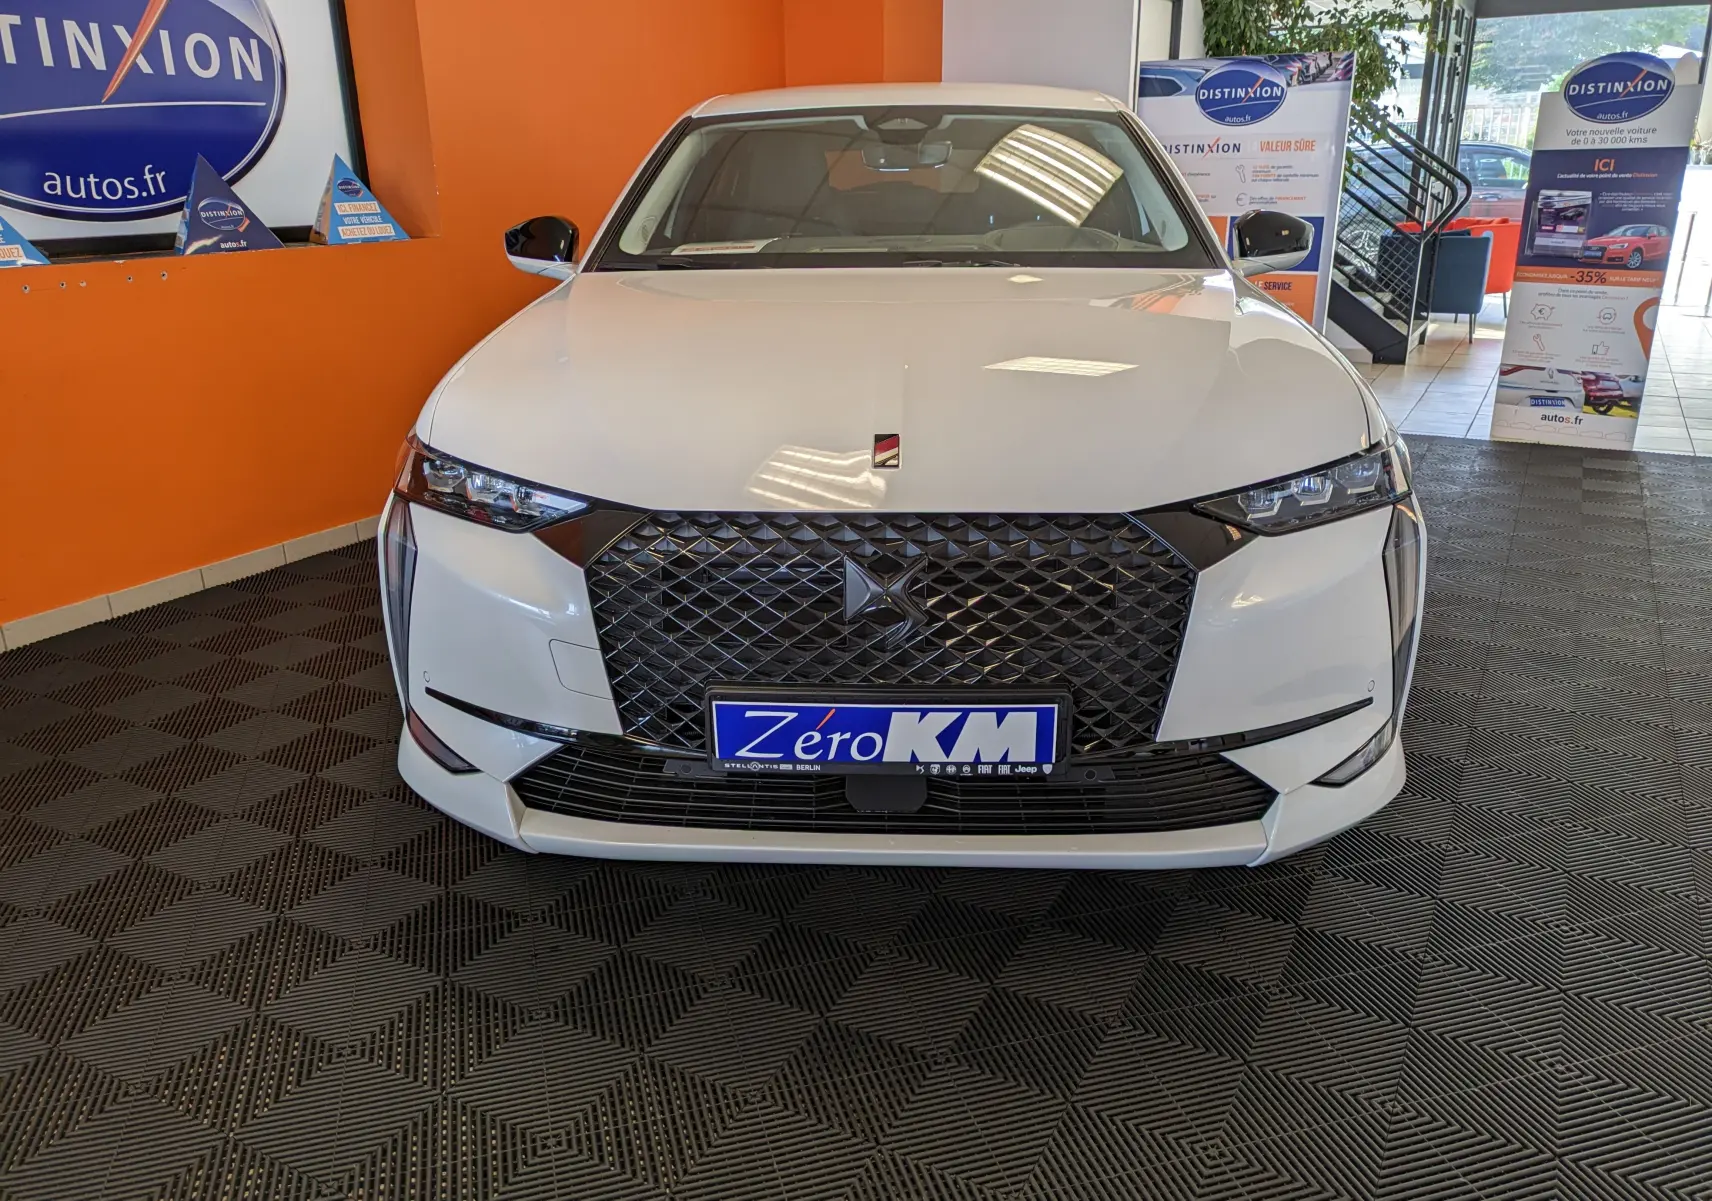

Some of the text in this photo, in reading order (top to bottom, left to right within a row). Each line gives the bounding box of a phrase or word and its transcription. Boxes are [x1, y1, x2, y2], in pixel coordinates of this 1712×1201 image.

[1200, 83, 1282, 101] DISTINXION
[1569, 76, 1669, 97] DISTINXION
[1225, 114, 1251, 123] autos.fr
[1597, 111, 1628, 120] autos.fr
[1566, 126, 1657, 137] Votre nouvelle voiture
[1260, 137, 1316, 152] VALEUR SÛRE
[1571, 137, 1581, 146] de
[1598, 136, 1608, 144] 30
[1611, 136, 1627, 144] 000
[1628, 135, 1648, 144] kms
[1594, 158, 1615, 172] ICI
[43, 164, 167, 201] autos.fr
[201, 208, 243, 218] DISTINXION
[220, 240, 247, 249] autos.fr
[1570, 270, 1607, 284] -35%
[1264, 282, 1292, 290] SERVICE
[1541, 413, 1583, 426] autos.fr
[735, 708, 1038, 762] Zéro KM
[978, 764, 992, 774] FIAT
[1015, 764, 1037, 774] Jeep
